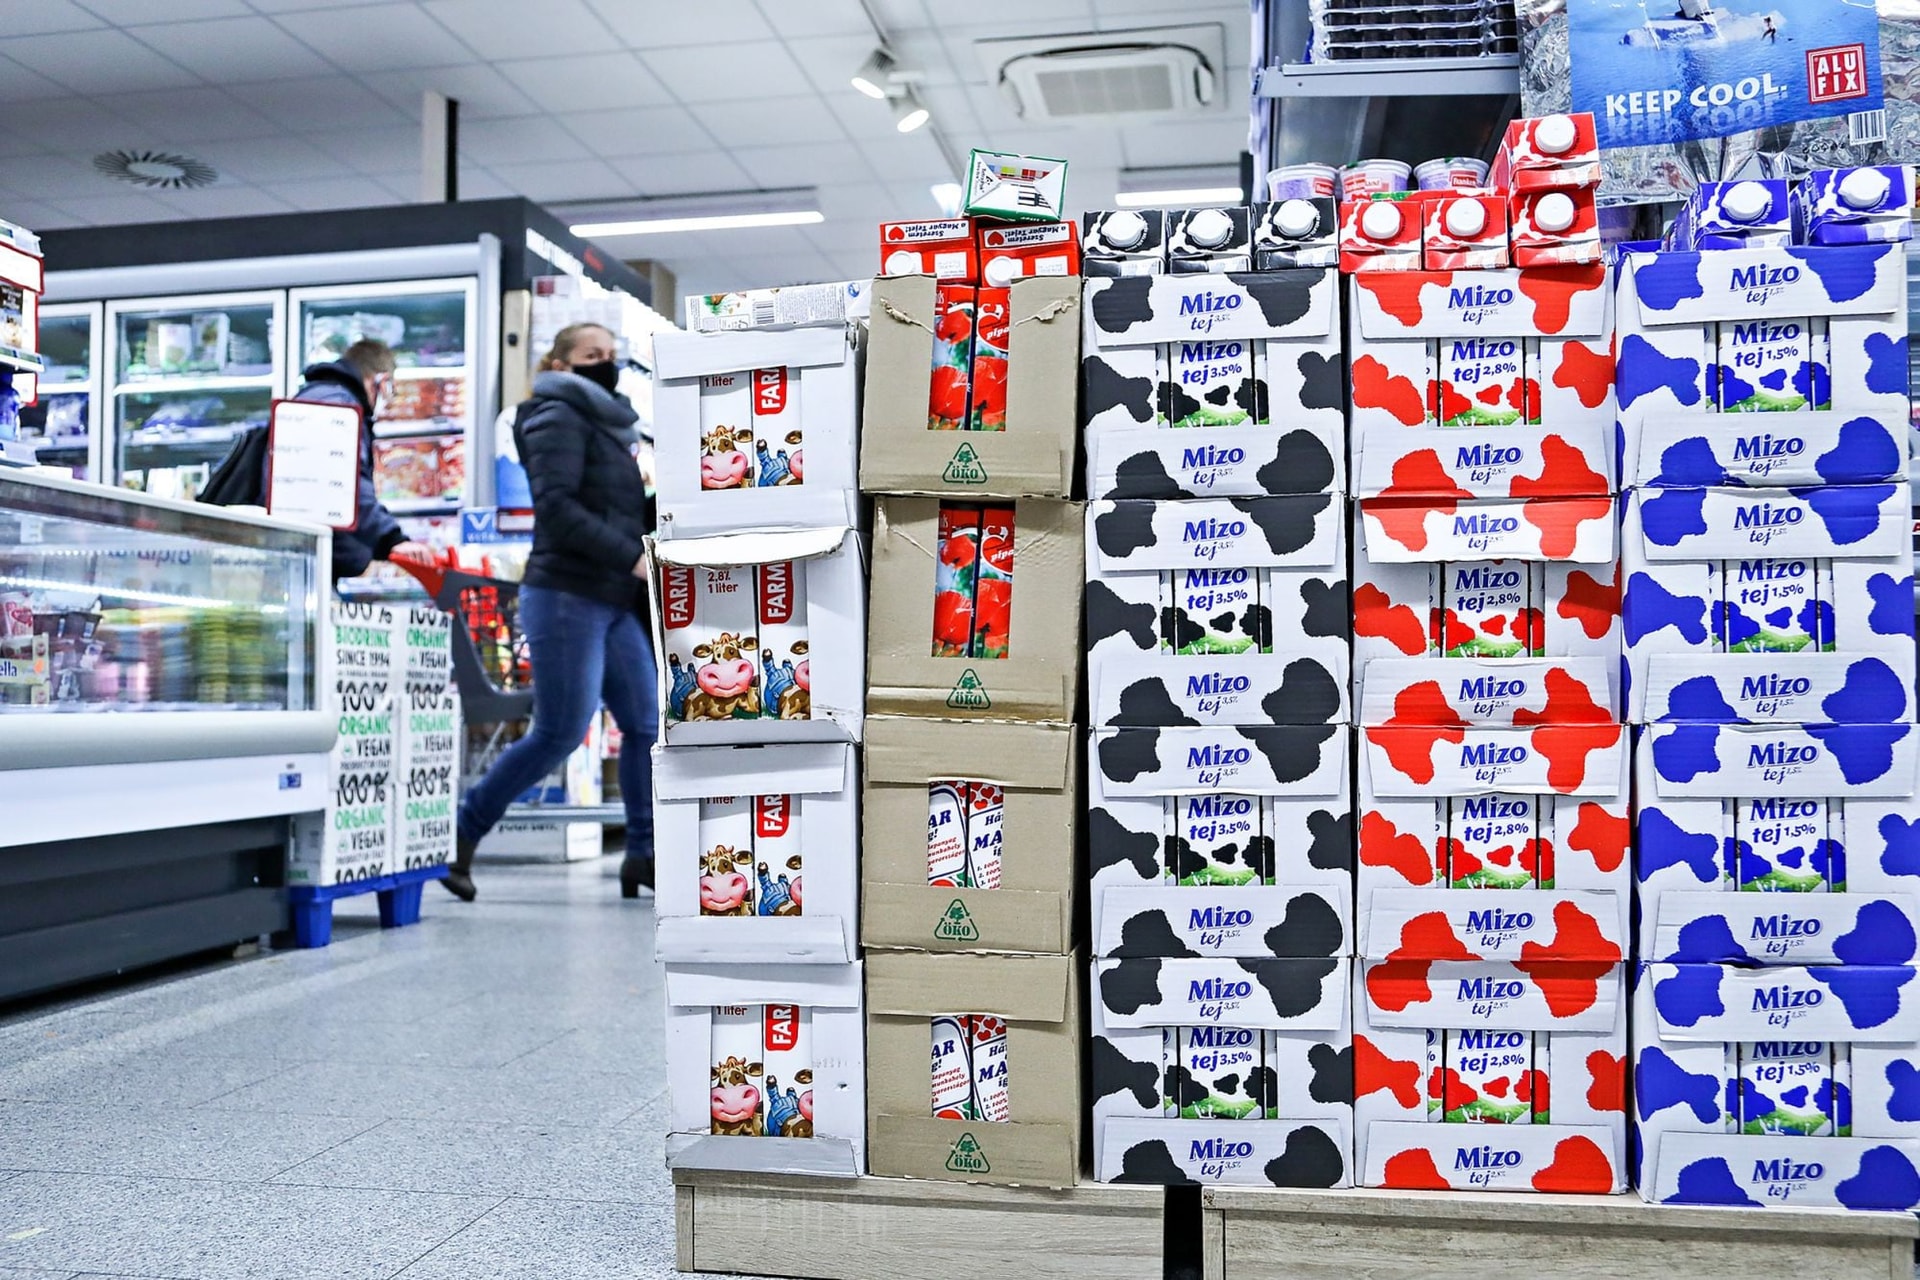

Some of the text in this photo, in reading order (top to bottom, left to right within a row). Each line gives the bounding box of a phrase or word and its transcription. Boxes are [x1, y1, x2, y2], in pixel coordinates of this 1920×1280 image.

[1817, 52, 1857, 76] ALU
[1817, 72, 1858, 96] FIX
[1606, 73, 1787, 117] KEEP COOL.
[905, 225, 928, 234] Tejet!
[908, 230, 944, 238] Szeretem
[929, 222, 960, 232] Magyar
[1004, 228, 1028, 238] Tejet!
[1028, 225, 1059, 234] Magyar
[1008, 234, 1044, 243] Szeretem
[1730, 263, 1799, 290] Mizo
[1180, 292, 1241, 315] Mizo
[1449, 285, 1513, 308] Mizo
[1747, 288, 1769, 305] tej
[1191, 315, 1214, 333] tej
[1463, 308, 1484, 325] tej
[1732, 321, 1799, 345] Mizo
[1180, 340, 1242, 363] Mizo
[1452, 337, 1515, 361] Mizo
[1734, 345, 1798, 368] tej 1,5%
[704, 375, 735, 388] 1 liter
[1183, 363, 1242, 385] tej 3,5%
[1453, 362, 1516, 384] tej 2,8%
[1182, 445, 1244, 469] Mizo
[1456, 443, 1521, 468] Mizo
[1734, 434, 1804, 459] Mizo
[951, 466, 979, 479] ÖKO
[1471, 468, 1492, 487] tej
[1750, 459, 1773, 476] tej
[1194, 469, 1216, 488] tej
[1453, 514, 1518, 535] Mizo
[1734, 503, 1802, 528] Mizo
[1183, 518, 1245, 541] Mizo
[1750, 528, 1773, 545] tej
[1194, 542, 1217, 560] tej
[1468, 536, 1489, 551] tej
[1185, 567, 1247, 588] Mizo
[1456, 567, 1519, 590] Mizo
[1738, 559, 1805, 582] Mizo
[708, 582, 738, 593] 1 liter
[1740, 584, 1804, 605] tej 1,5%
[1187, 589, 1247, 611] tej 3,5%
[1457, 592, 1520, 613] tej 2,8%
[407, 628, 448, 648] ORGANIC
[337, 649, 365, 665] SINCE
[420, 651, 446, 668] VEGAN
[1187, 673, 1249, 696] Mizo
[1459, 676, 1524, 699] Mizo
[1741, 674, 1809, 698] Mizo
[955, 693, 982, 705] ÖKO
[1198, 697, 1221, 715] tej
[1474, 700, 1495, 717] tej
[1756, 698, 1779, 716] tej
[339, 715, 391, 735] ORGANIC
[411, 714, 453, 732] ORGANIC
[357, 739, 391, 757] VEGAN
[424, 735, 452, 752] VEGAN
[1749, 741, 1817, 766] Mizo
[1187, 744, 1249, 768] Mizo
[1461, 743, 1526, 766] Mizo
[1199, 768, 1222, 787] tej
[1475, 767, 1497, 784] tej
[1763, 767, 1787, 784] tej
[405, 800, 450, 821] ORGANIC
[764, 794, 783, 831] FAR
[1188, 795, 1250, 818] Mizo
[1462, 796, 1528, 820] Mizo
[1751, 798, 1817, 820] Mizo
[335, 805, 385, 830] ORGANIC
[422, 819, 450, 838] VEGAN
[1189, 821, 1250, 841] tej 3,5%
[1464, 822, 1529, 843] tej 2,8%
[1752, 823, 1816, 844] tej 1,5%
[351, 829, 385, 850] VEGAN
[1189, 906, 1251, 929] Mizo
[1466, 908, 1533, 931] Mizo
[1752, 914, 1820, 938] Mizo
[943, 922, 970, 936] ÖKO
[1200, 930, 1224, 948] tej
[1481, 933, 1502, 950] tej
[1766, 940, 1789, 956] tej
[1189, 977, 1250, 1000] Mizo
[1458, 977, 1524, 1000] Mizo
[1752, 985, 1821, 1010] Mizo
[717, 1006, 747, 1016] 1 liter
[1200, 1001, 1223, 1020] tej
[1472, 1001, 1494, 1018] tej
[1768, 1012, 1791, 1028] tej
[772, 1005, 791, 1044] FAR
[1189, 1027, 1252, 1048] Mizo
[1458, 1030, 1524, 1050] Mizo
[1753, 1041, 1822, 1058] Mizo
[1191, 1051, 1252, 1071] tej 3,5%
[1460, 1053, 1524, 1074] tej 2,8%
[1756, 1061, 1820, 1083] tej 1,5%
[1190, 1138, 1252, 1160] Mizo
[1455, 1146, 1521, 1168] Mizo
[955, 1155, 982, 1168] ÖKO
[1201, 1161, 1224, 1179] tej
[1752, 1158, 1823, 1181] Mizo
[1469, 1170, 1491, 1187] tej
[1768, 1183, 1791, 1201] tej
